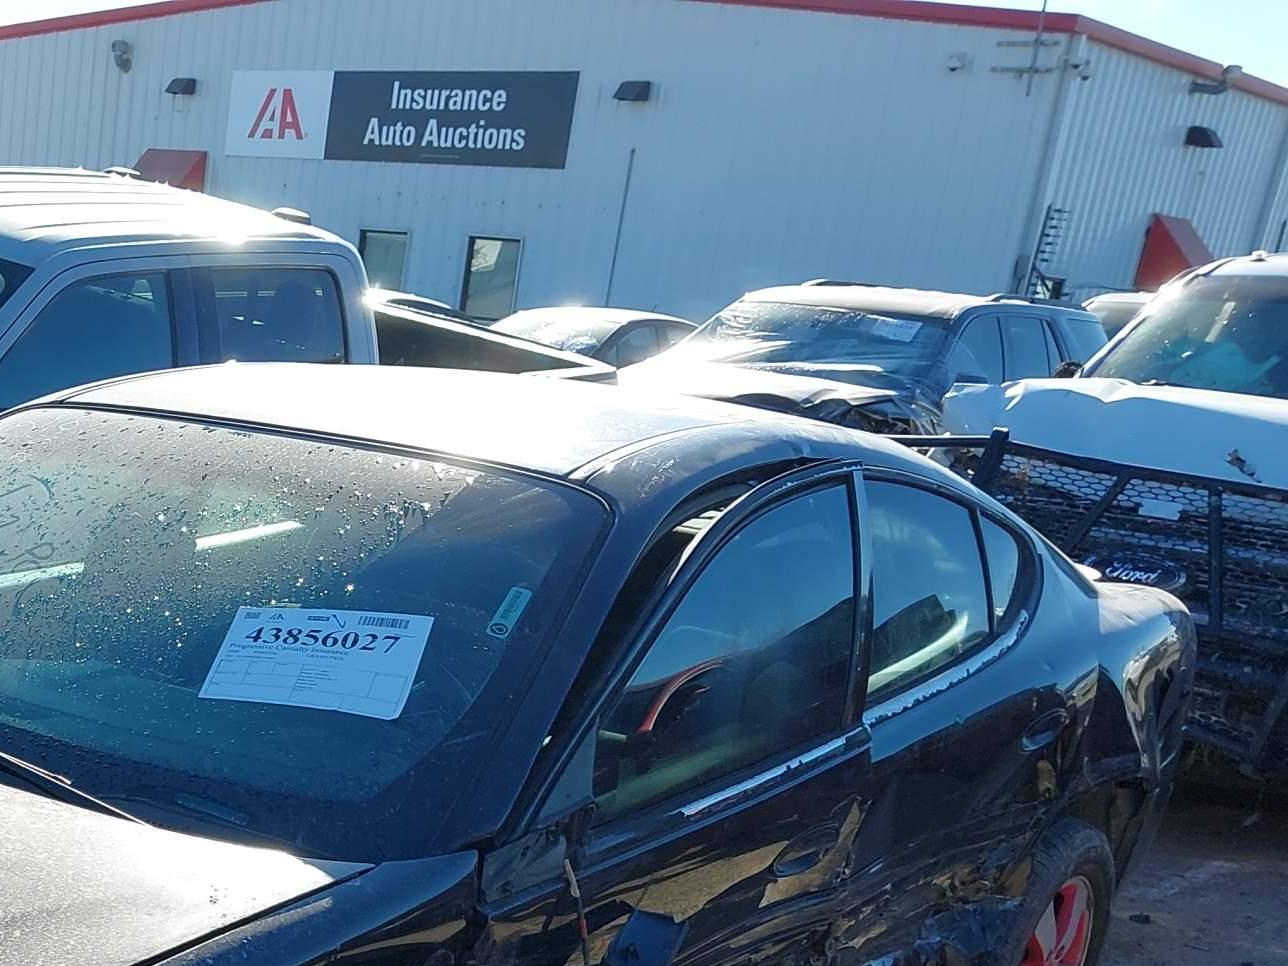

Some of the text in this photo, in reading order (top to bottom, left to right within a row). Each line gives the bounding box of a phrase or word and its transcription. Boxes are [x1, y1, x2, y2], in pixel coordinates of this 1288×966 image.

[391, 81, 507, 112] Insurance
[363, 117, 527, 151] Auto Auctions
[1104, 561, 1162, 585] Ford
[245, 626, 401, 654] 43856027
